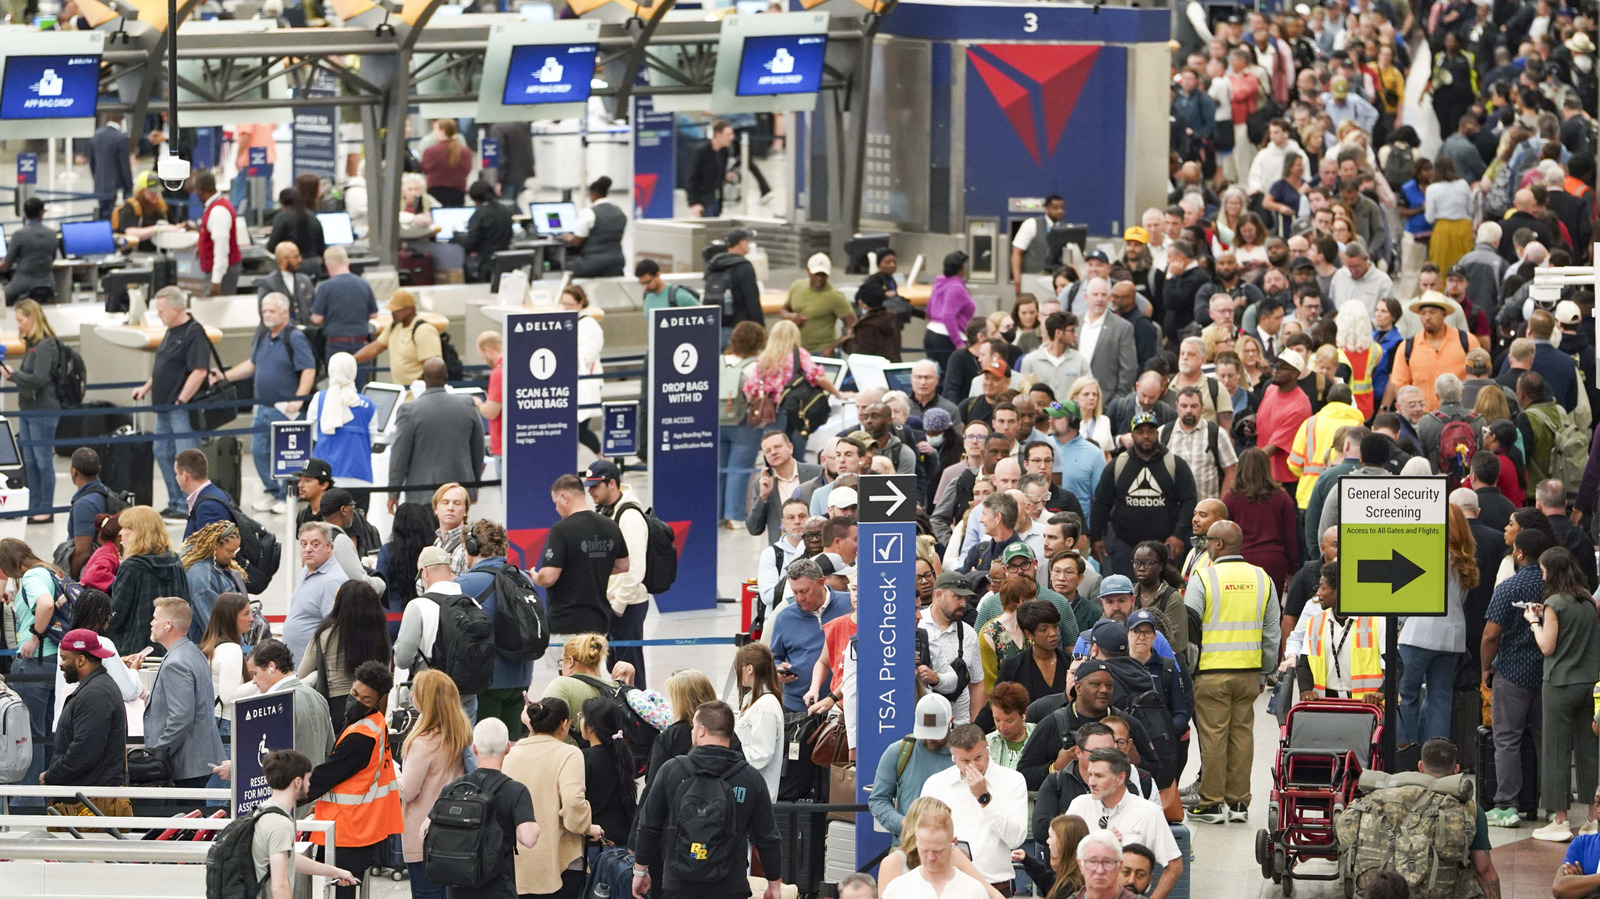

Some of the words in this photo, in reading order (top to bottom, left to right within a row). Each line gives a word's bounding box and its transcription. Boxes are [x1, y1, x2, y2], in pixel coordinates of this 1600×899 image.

[1023, 12, 1038, 32] 3
[525, 320, 562, 332] DELTA
[670, 316, 704, 326] DELTA
[540, 355, 546, 373] 1
[681, 350, 690, 368] 2
[516, 388, 540, 398] SCAN
[542, 387, 549, 398] &
[550, 386, 570, 397] TAG
[662, 382, 685, 393] DROP
[686, 381, 709, 392] BAGS
[517, 399, 543, 410] YOUR
[544, 398, 568, 408] BAGS
[668, 393, 692, 404] WITH
[692, 392, 702, 402] ID
[1348, 486, 1390, 500] General
[1394, 487, 1440, 502] Security
[1126, 496, 1166, 506] Reebok
[1366, 506, 1422, 521] Screening
[253, 706, 276, 718] DELTA
[879, 689, 896, 734] TSA
[244, 790, 256, 800] FOR
